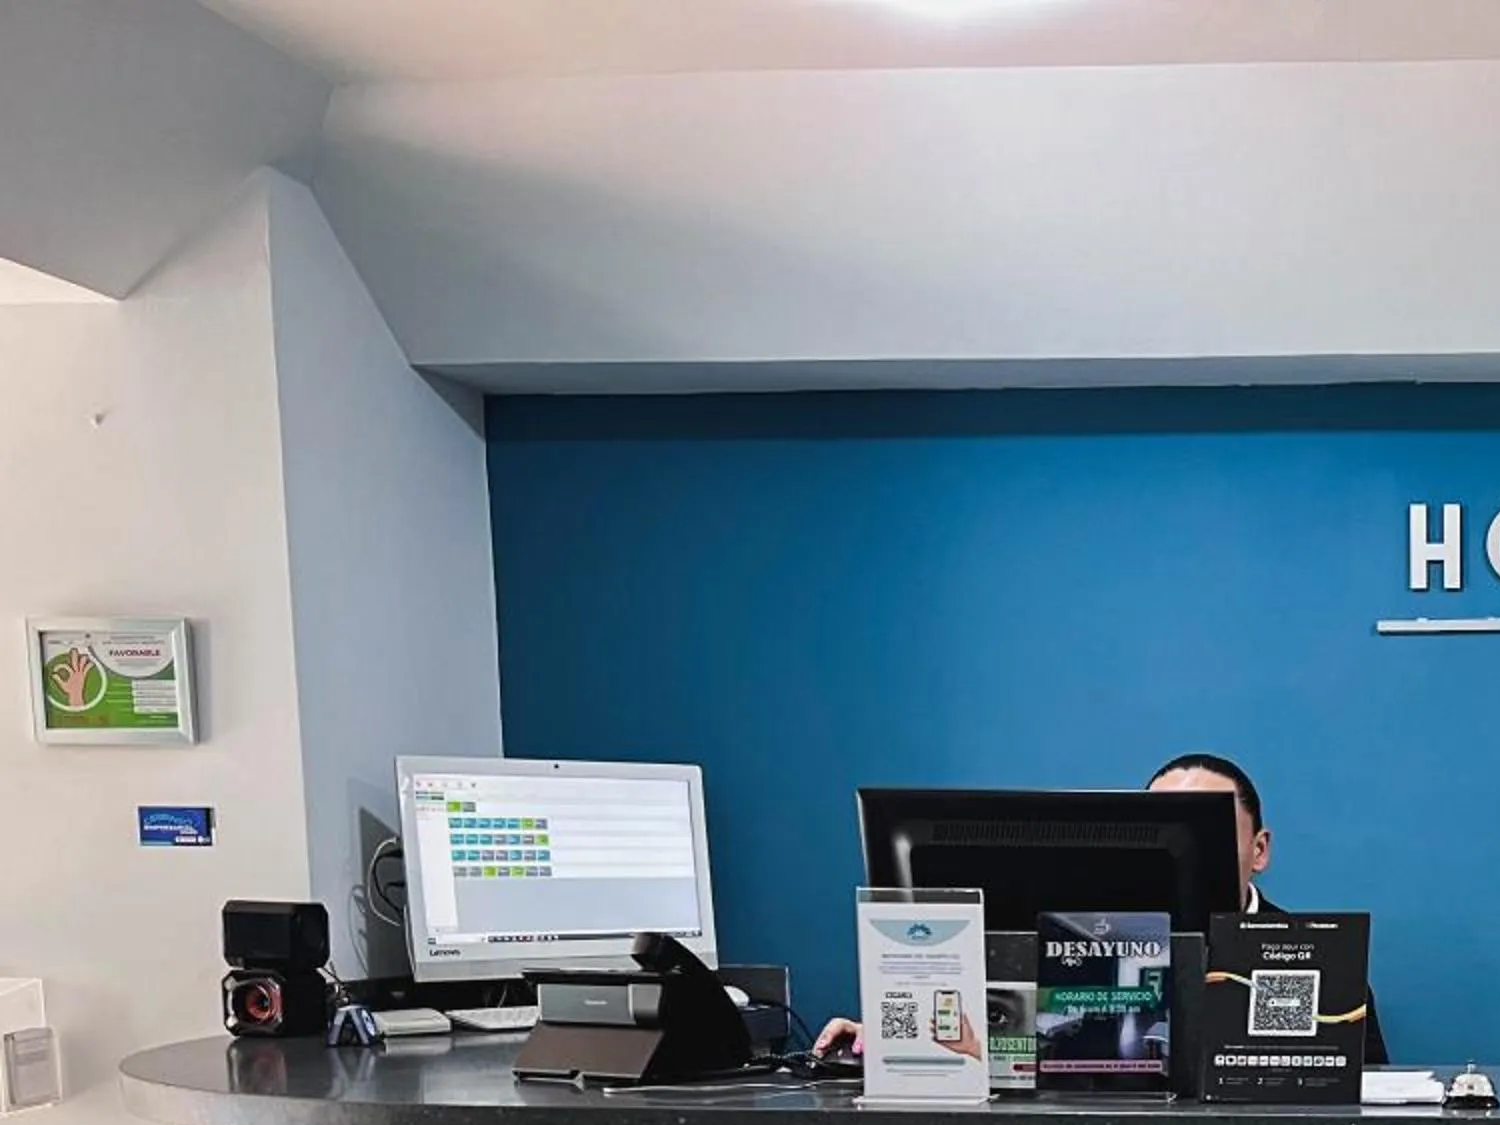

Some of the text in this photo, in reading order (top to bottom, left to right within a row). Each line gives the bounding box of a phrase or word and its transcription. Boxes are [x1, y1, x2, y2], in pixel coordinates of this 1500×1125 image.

[429, 948, 461, 957] Lenovo
[1045, 941, 1161, 958] DESAYUNO
[1055, 991, 1152, 1001] HORARIO DE SERVICIO
